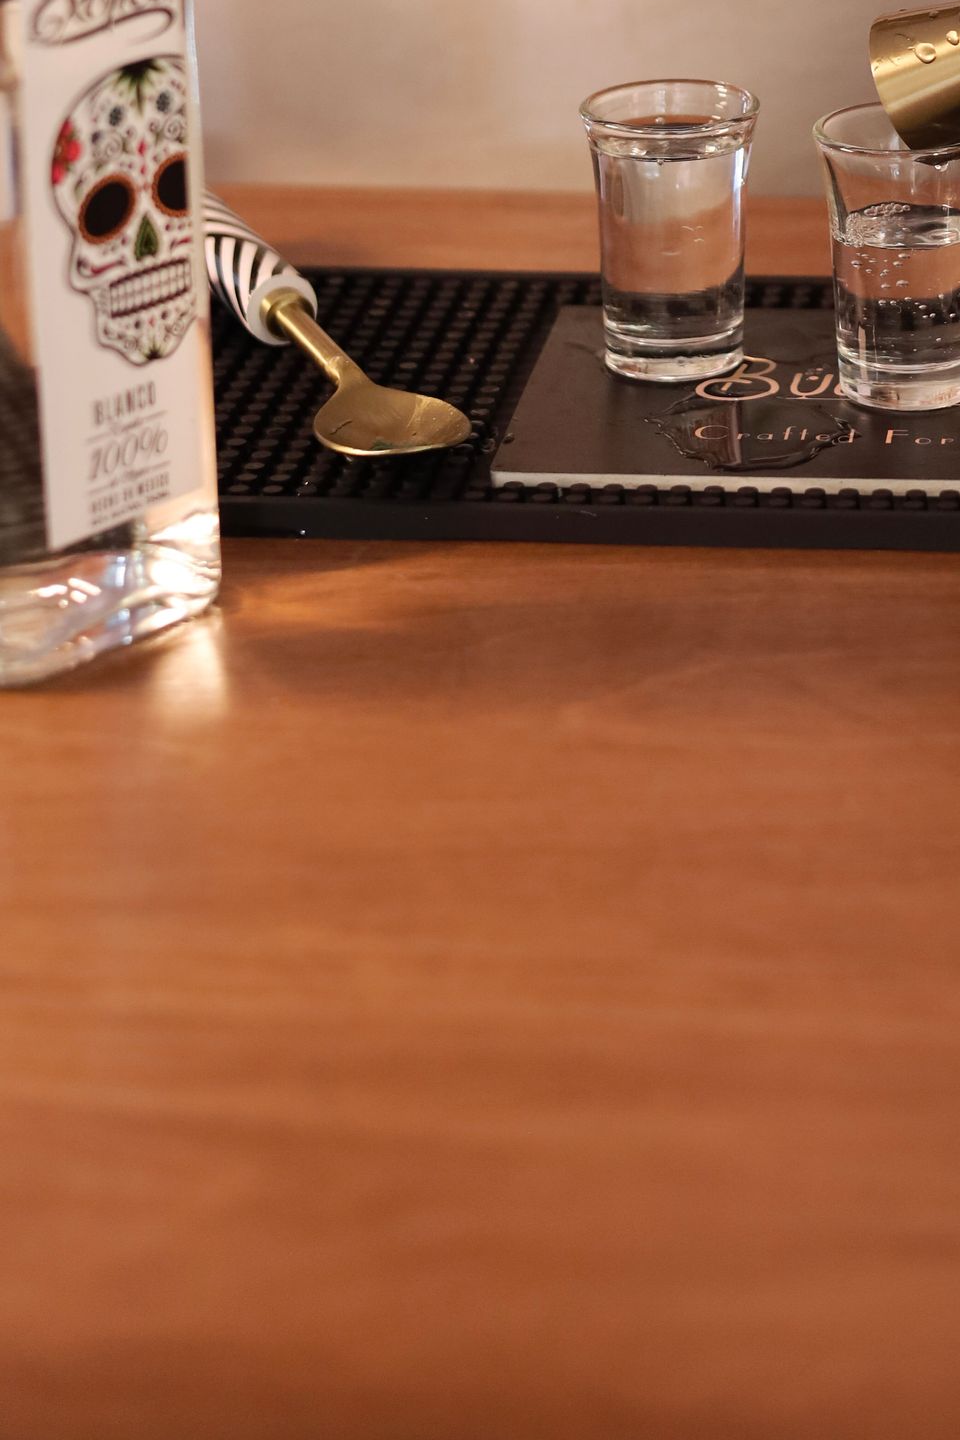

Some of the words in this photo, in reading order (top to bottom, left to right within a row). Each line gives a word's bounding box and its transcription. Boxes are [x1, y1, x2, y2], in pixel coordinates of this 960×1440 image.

[93, 380, 157, 425] BLANCO
[88, 422, 169, 482] 100%
[694, 424, 856, 446] Crafted
[884, 428, 954, 446] For
